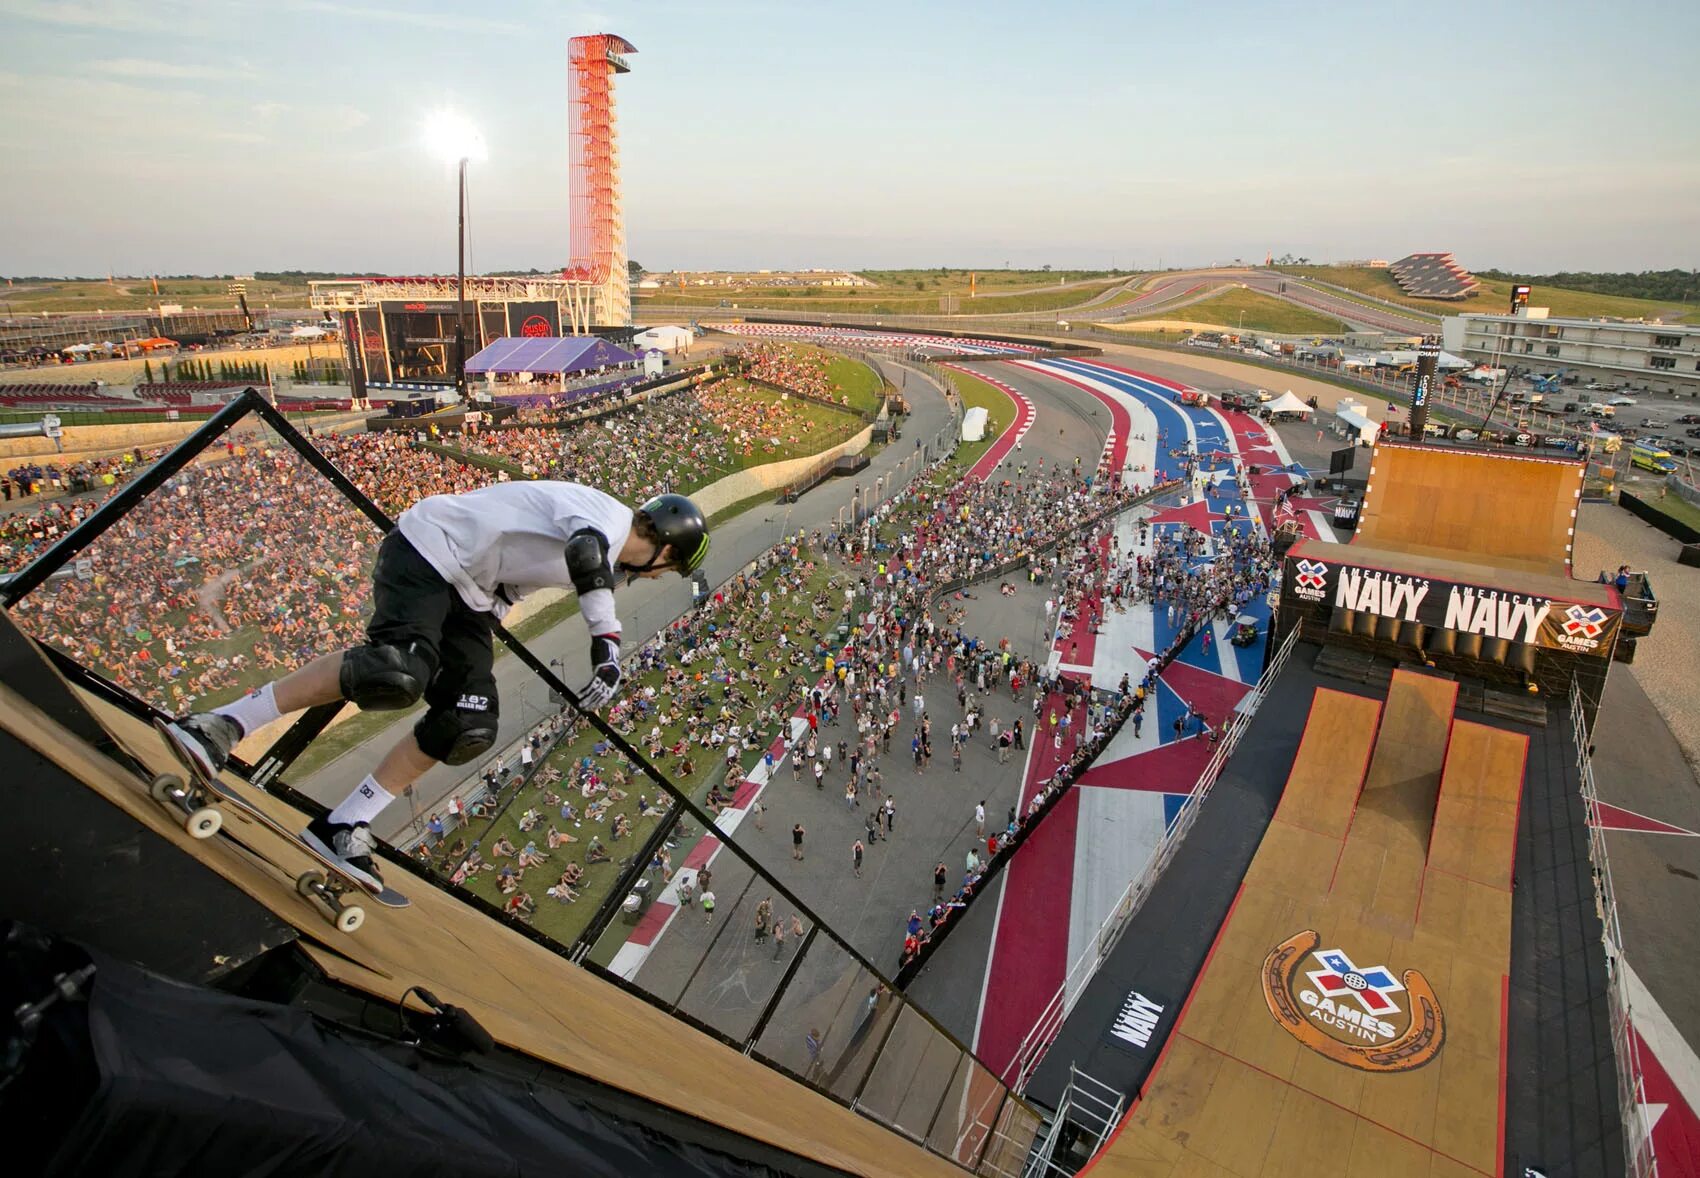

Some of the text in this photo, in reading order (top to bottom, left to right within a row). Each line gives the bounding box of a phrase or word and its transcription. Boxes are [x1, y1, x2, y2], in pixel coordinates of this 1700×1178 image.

[1335, 506, 1356, 518] NAVY
[1294, 586, 1326, 598] GAMES
[1299, 594, 1321, 602] AUSTIN
[1335, 572, 1430, 622] NAVY
[1444, 593, 1551, 644] NAVY
[1557, 634, 1599, 648] GAMES
[1561, 643, 1589, 653] AUSTIN
[460, 694, 488, 705] 187
[1117, 992, 1164, 1048] NAVY
[1299, 990, 1396, 1038] GAMES
[1310, 1009, 1377, 1043] AUSTIN
